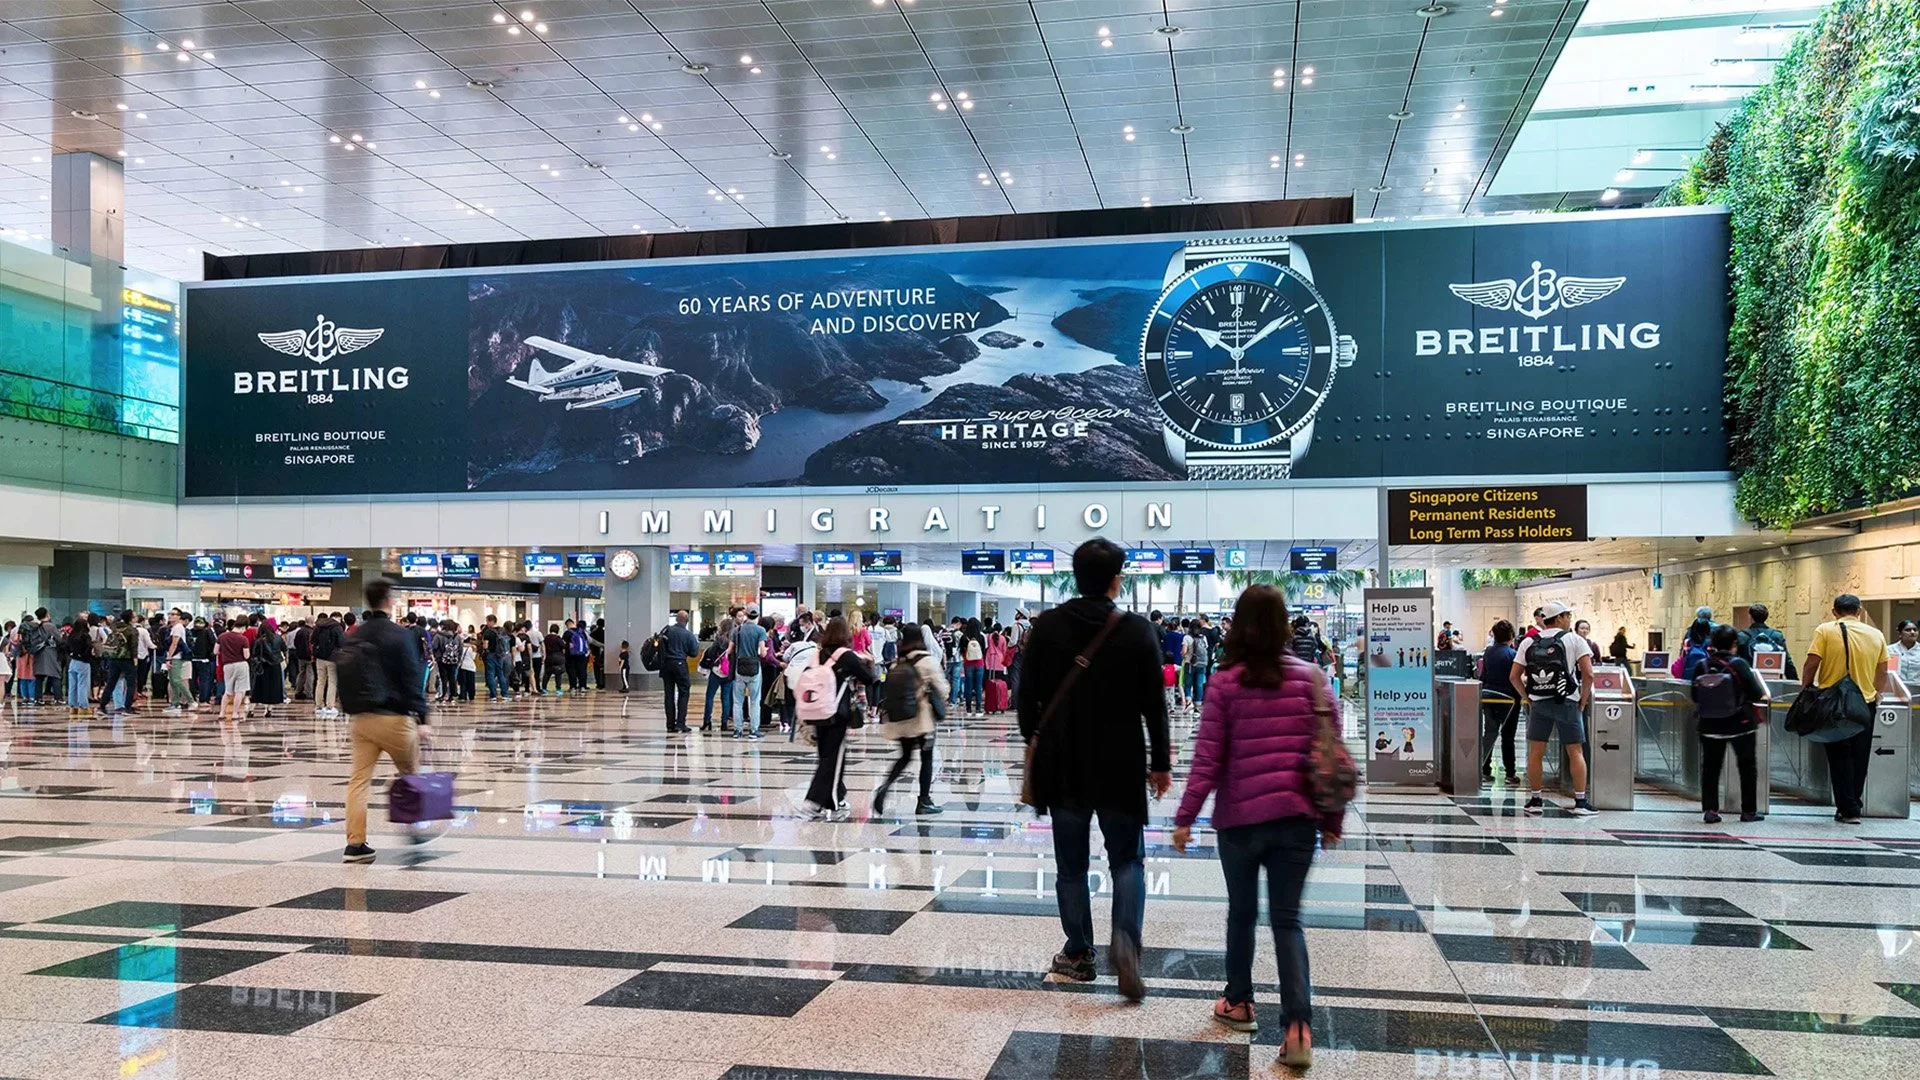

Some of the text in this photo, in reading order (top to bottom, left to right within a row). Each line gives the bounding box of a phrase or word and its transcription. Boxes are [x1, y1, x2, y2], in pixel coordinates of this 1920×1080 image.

[678, 287, 936, 315] 60 YEARS OF ADVENTURE
[810, 312, 981, 335] AND DISCOVERY
[1414, 322, 1661, 356] BREITLING
[1518, 355, 1554, 367] 1884
[234, 367, 409, 394] BREITLING
[306, 394, 334, 404] 1884
[1446, 398, 1627, 414] BREITLING BOUTIQUE
[255, 430, 386, 442] BREITLING BOUTIQUE
[941, 420, 1089, 440] HERITAGE
[1486, 426, 1584, 440] SINGAPORE
[982, 440, 1047, 449] SINCE 1957
[284, 454, 355, 465] SINGAPORE
[1409, 490, 1538, 506] Singapore Citizens
[600, 503, 1172, 534] IMMIGRATION
[1409, 507, 1556, 522] Permanent Residents
[1409, 525, 1574, 542] Long Term Pass Holders
[1304, 584, 1324, 598] 48
[1372, 603, 1417, 615] Help us
[1374, 690, 1426, 702] Help you
[1606, 707, 1619, 717] 17
[1881, 712, 1895, 722] 19
